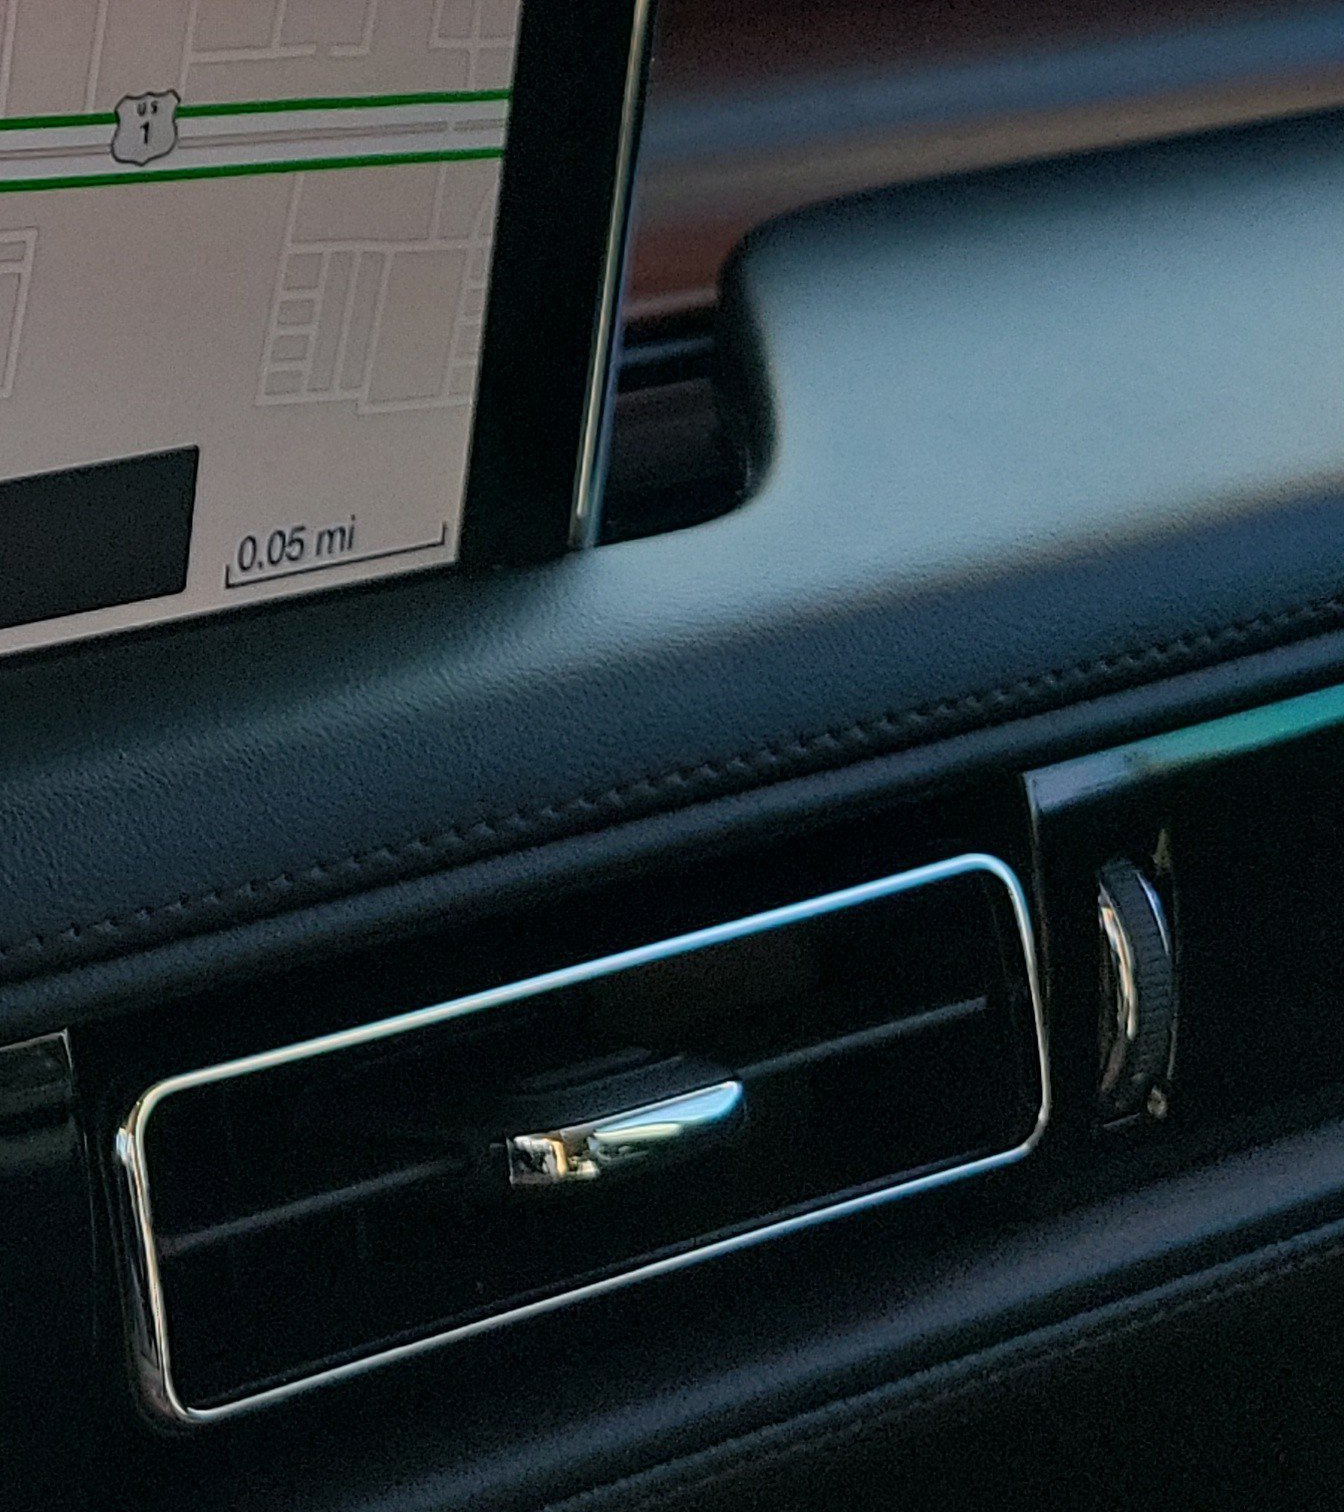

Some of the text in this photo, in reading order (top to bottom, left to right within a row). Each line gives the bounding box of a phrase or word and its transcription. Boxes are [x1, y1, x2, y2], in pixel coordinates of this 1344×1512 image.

[140, 121, 150, 144] 1
[236, 514, 357, 572] 0.05 mi
